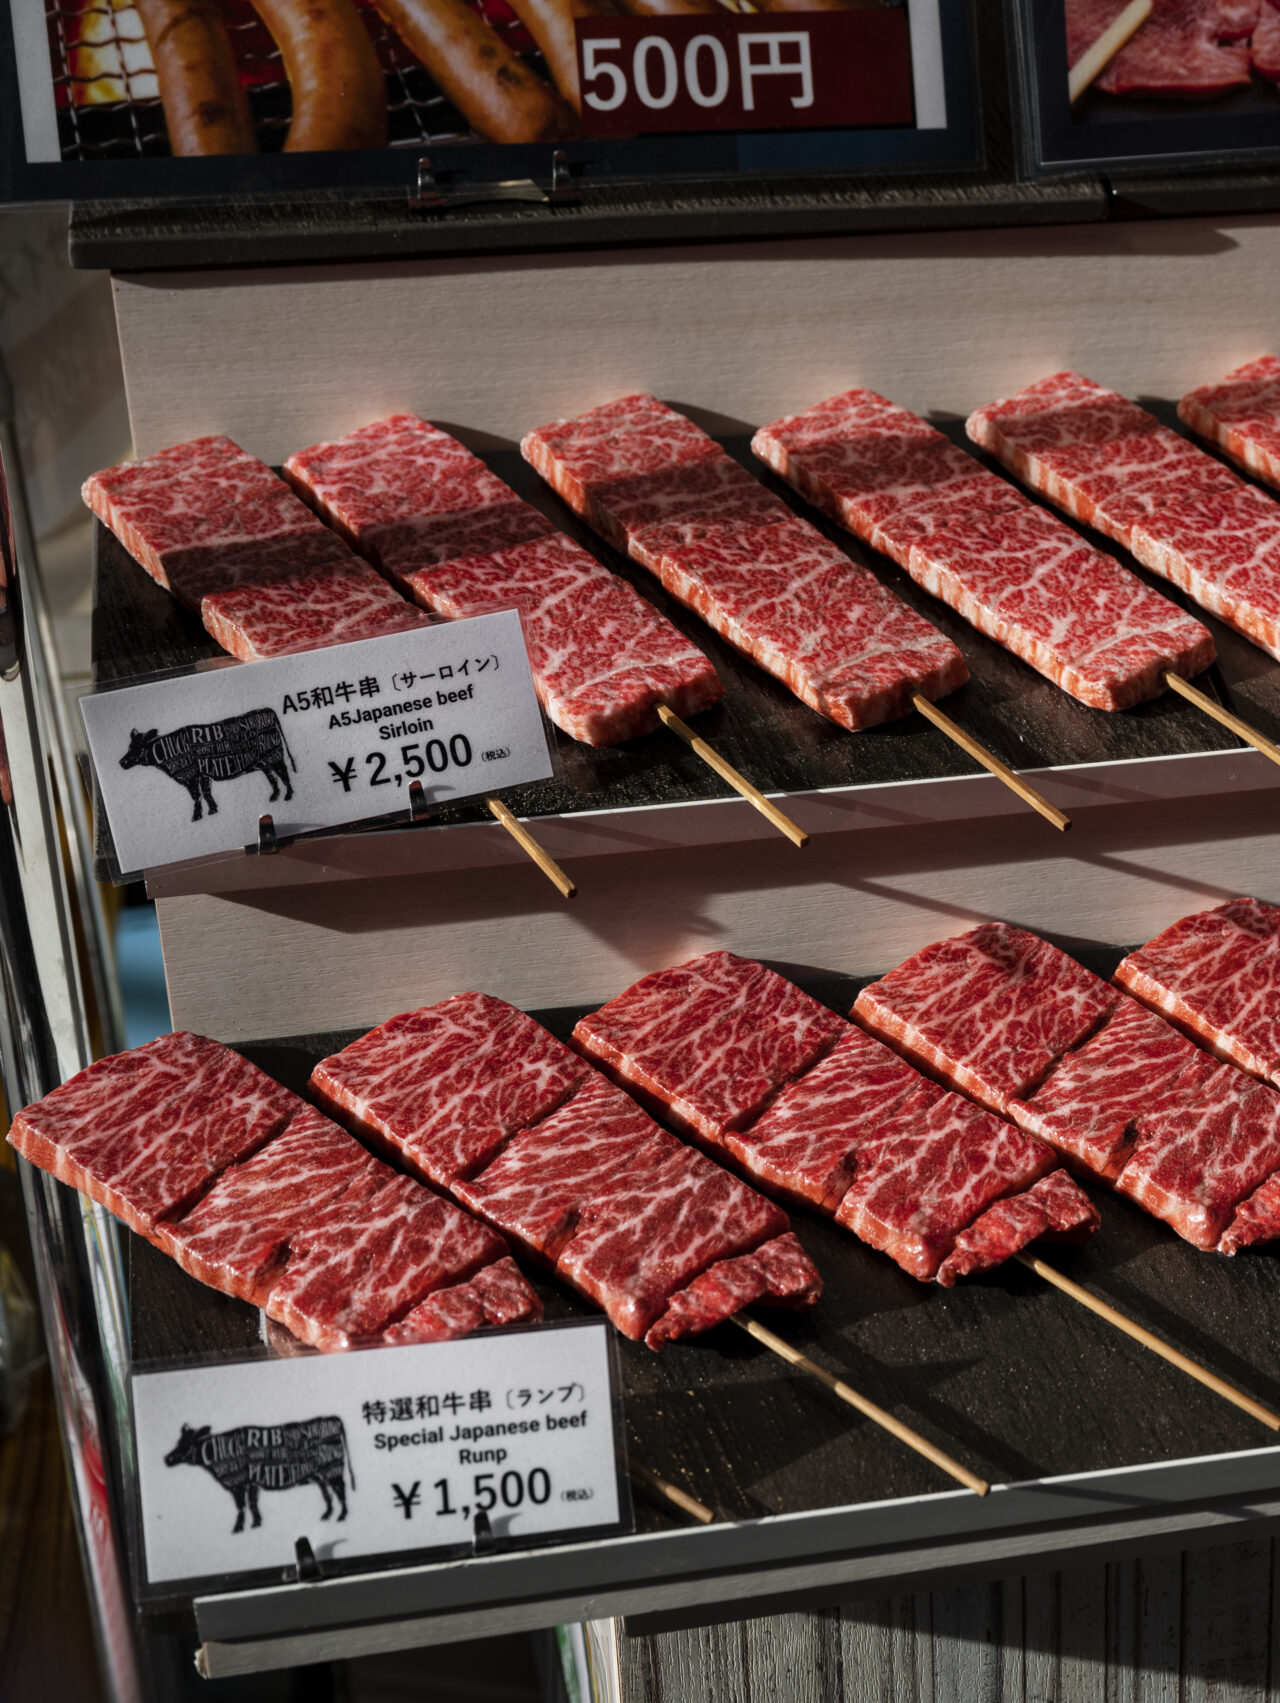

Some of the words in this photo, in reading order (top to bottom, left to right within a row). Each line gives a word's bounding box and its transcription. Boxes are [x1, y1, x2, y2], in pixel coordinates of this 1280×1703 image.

[582, 31, 814, 111] 500円
[329, 695, 433, 729] A5Japanese
[436, 684, 474, 706] beef
[191, 724, 223, 744] RIB
[379, 718, 434, 740] Sirloin
[198, 755, 235, 777] PLATE
[247, 1428, 283, 1447] RIB
[374, 1426, 444, 1452] Special
[449, 1419, 540, 1443] Japanese
[546, 1410, 587, 1431] beef
[458, 1447, 508, 1465] Runp
